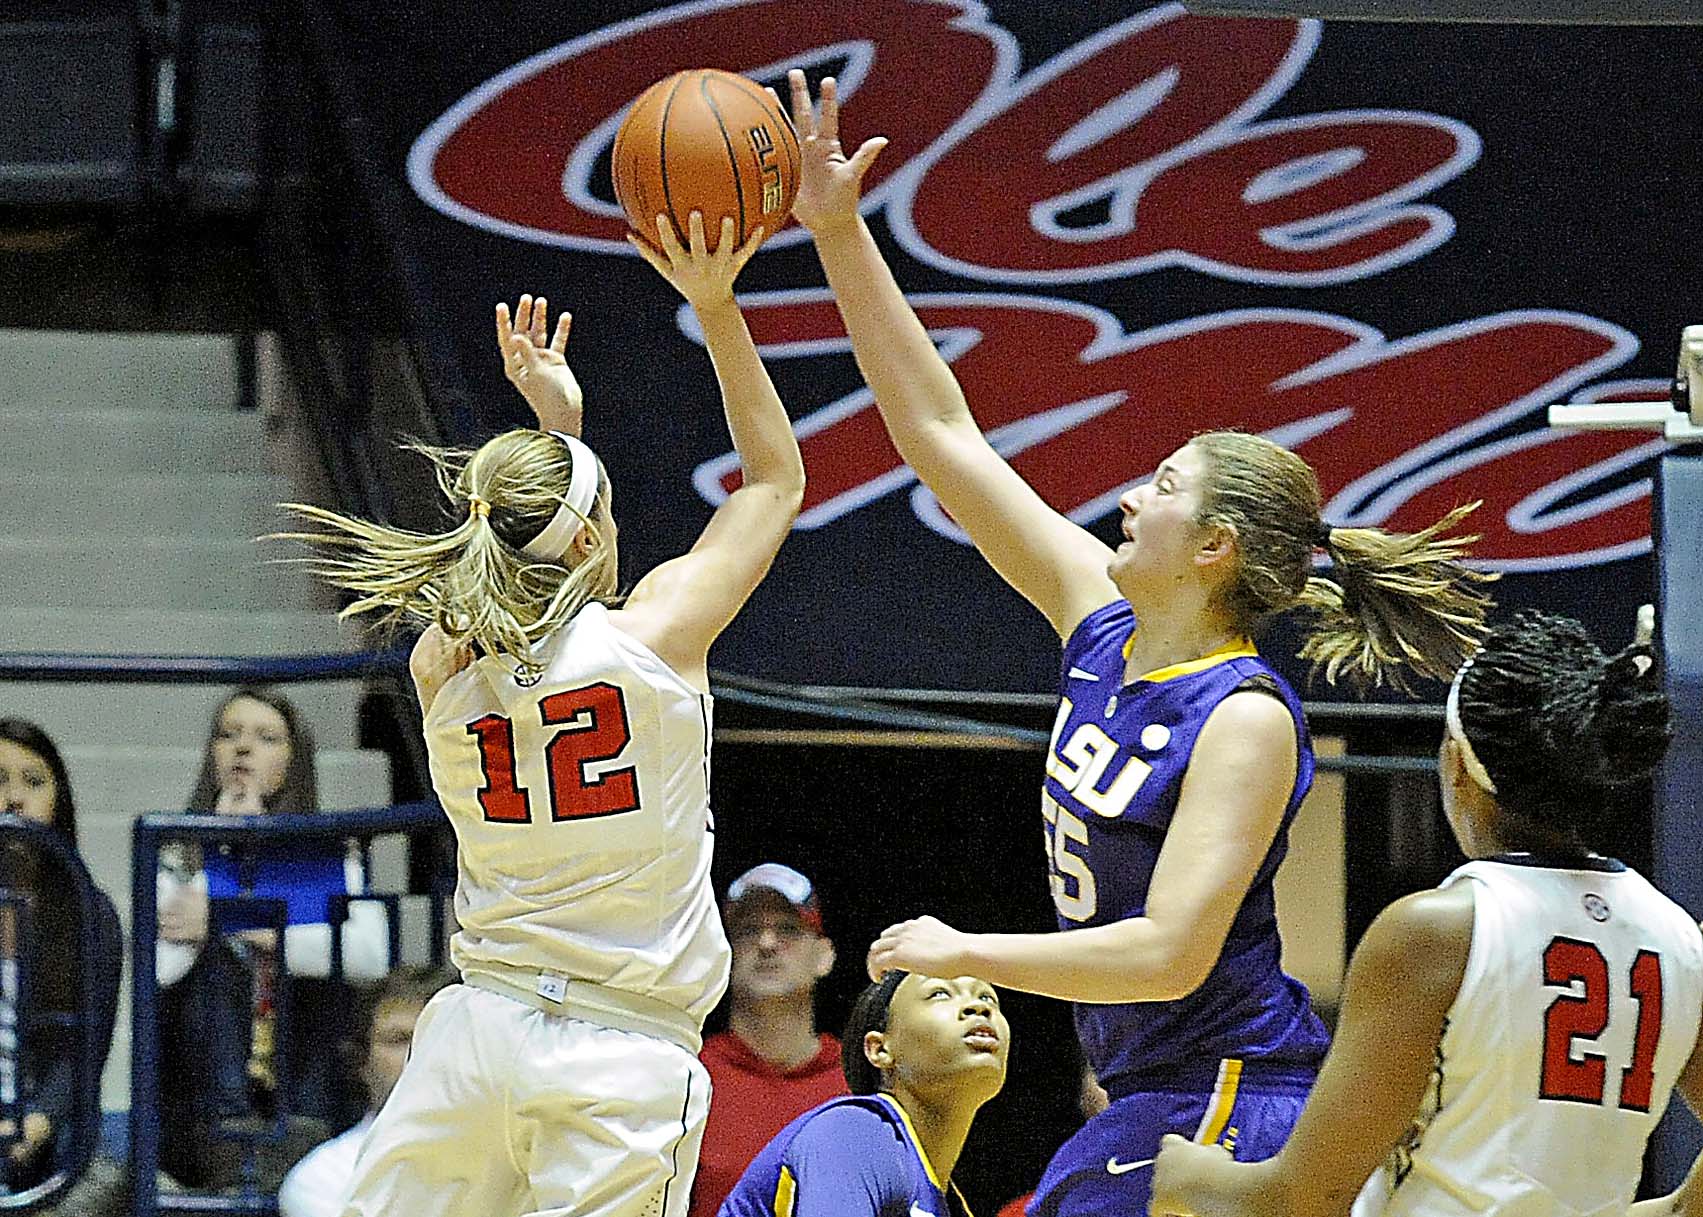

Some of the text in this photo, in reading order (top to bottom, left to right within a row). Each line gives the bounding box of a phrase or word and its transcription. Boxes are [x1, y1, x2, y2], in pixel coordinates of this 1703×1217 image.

[405, 0, 1482, 287] Ole
[750, 124, 782, 213] ELITE
[466, 681, 642, 824] 12
[1046, 697, 1153, 818] LSU
[1538, 935, 1663, 1114] 21
